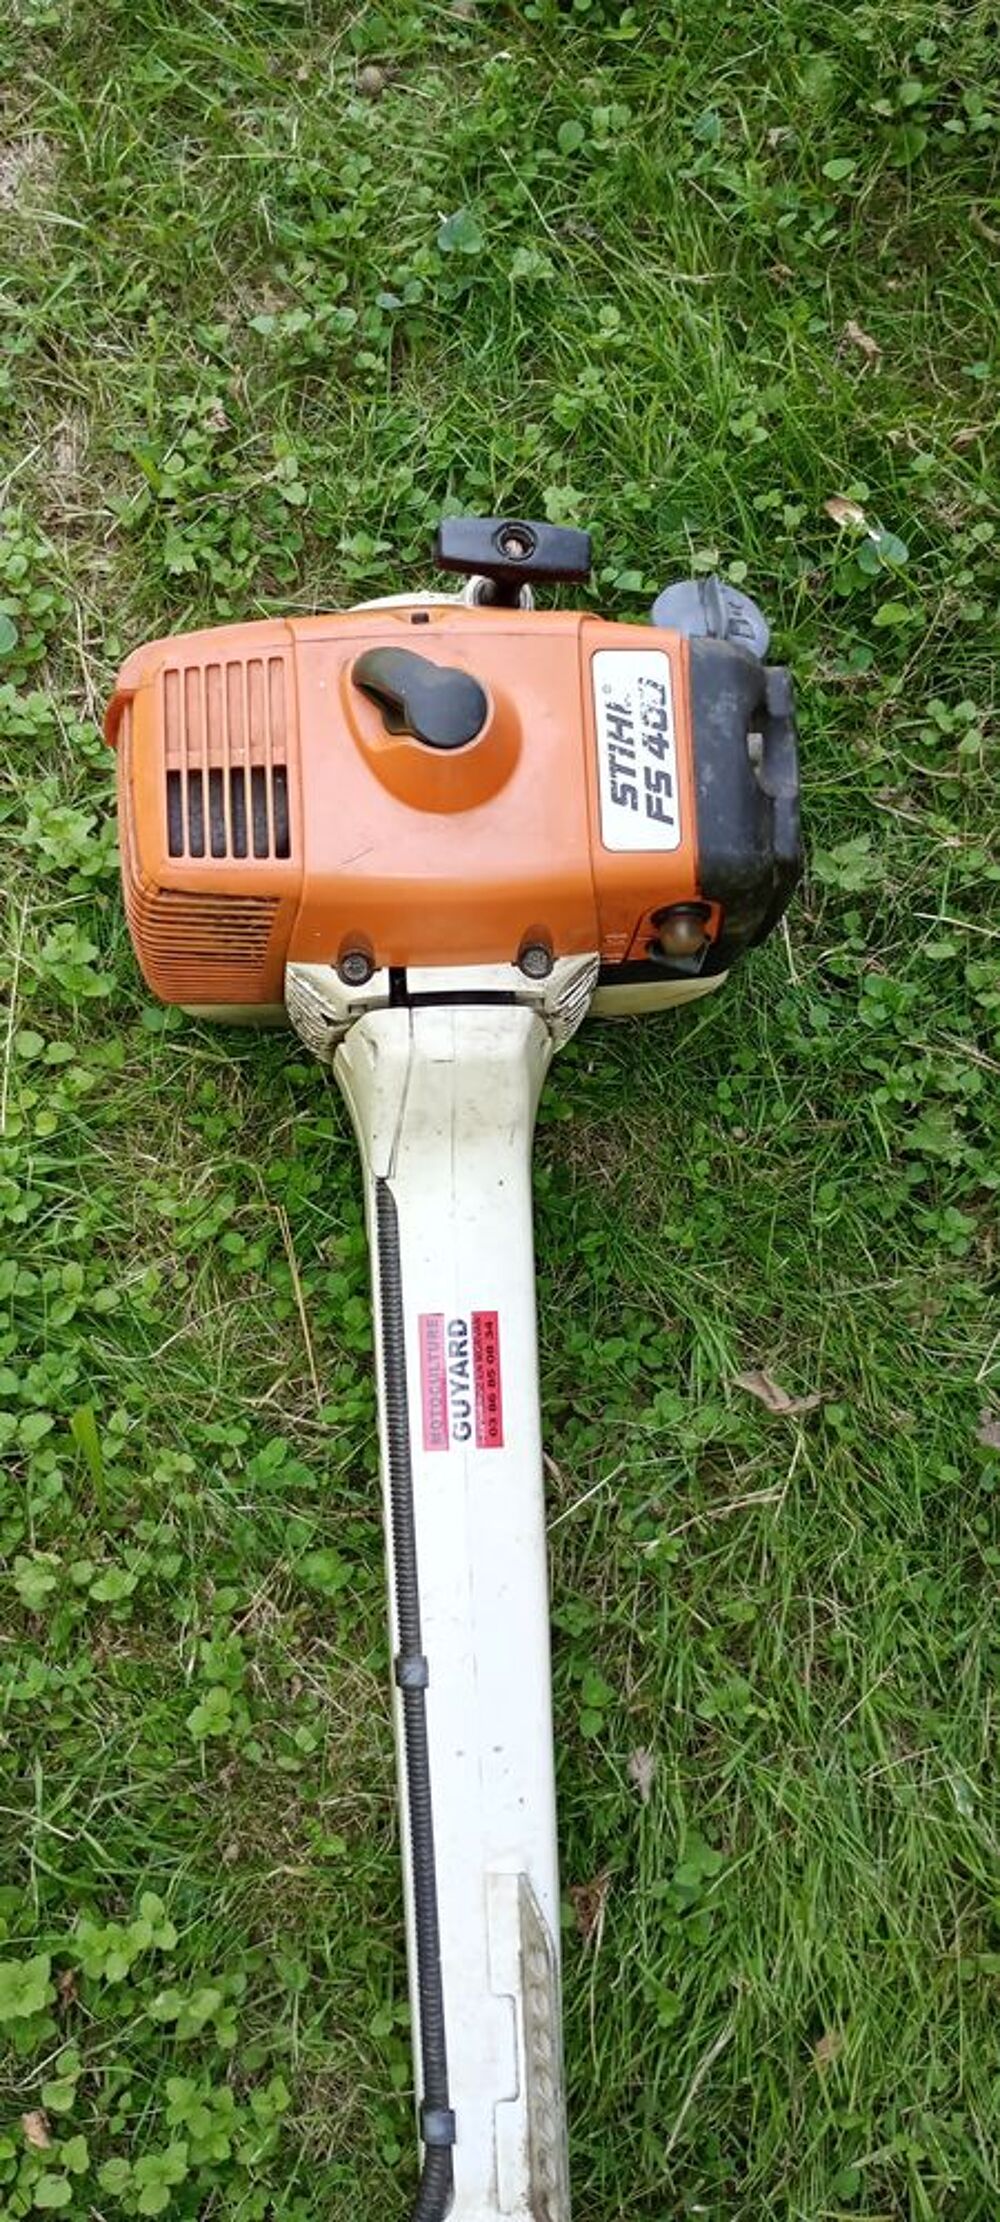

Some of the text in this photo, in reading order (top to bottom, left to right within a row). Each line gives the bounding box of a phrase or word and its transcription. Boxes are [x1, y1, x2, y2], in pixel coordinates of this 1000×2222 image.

[643, 766, 674, 826] FS
[426, 1318, 444, 1445] MOTOCULTURE
[447, 1318, 472, 1442] GUYARD
[486, 1417, 498, 1437] 03
